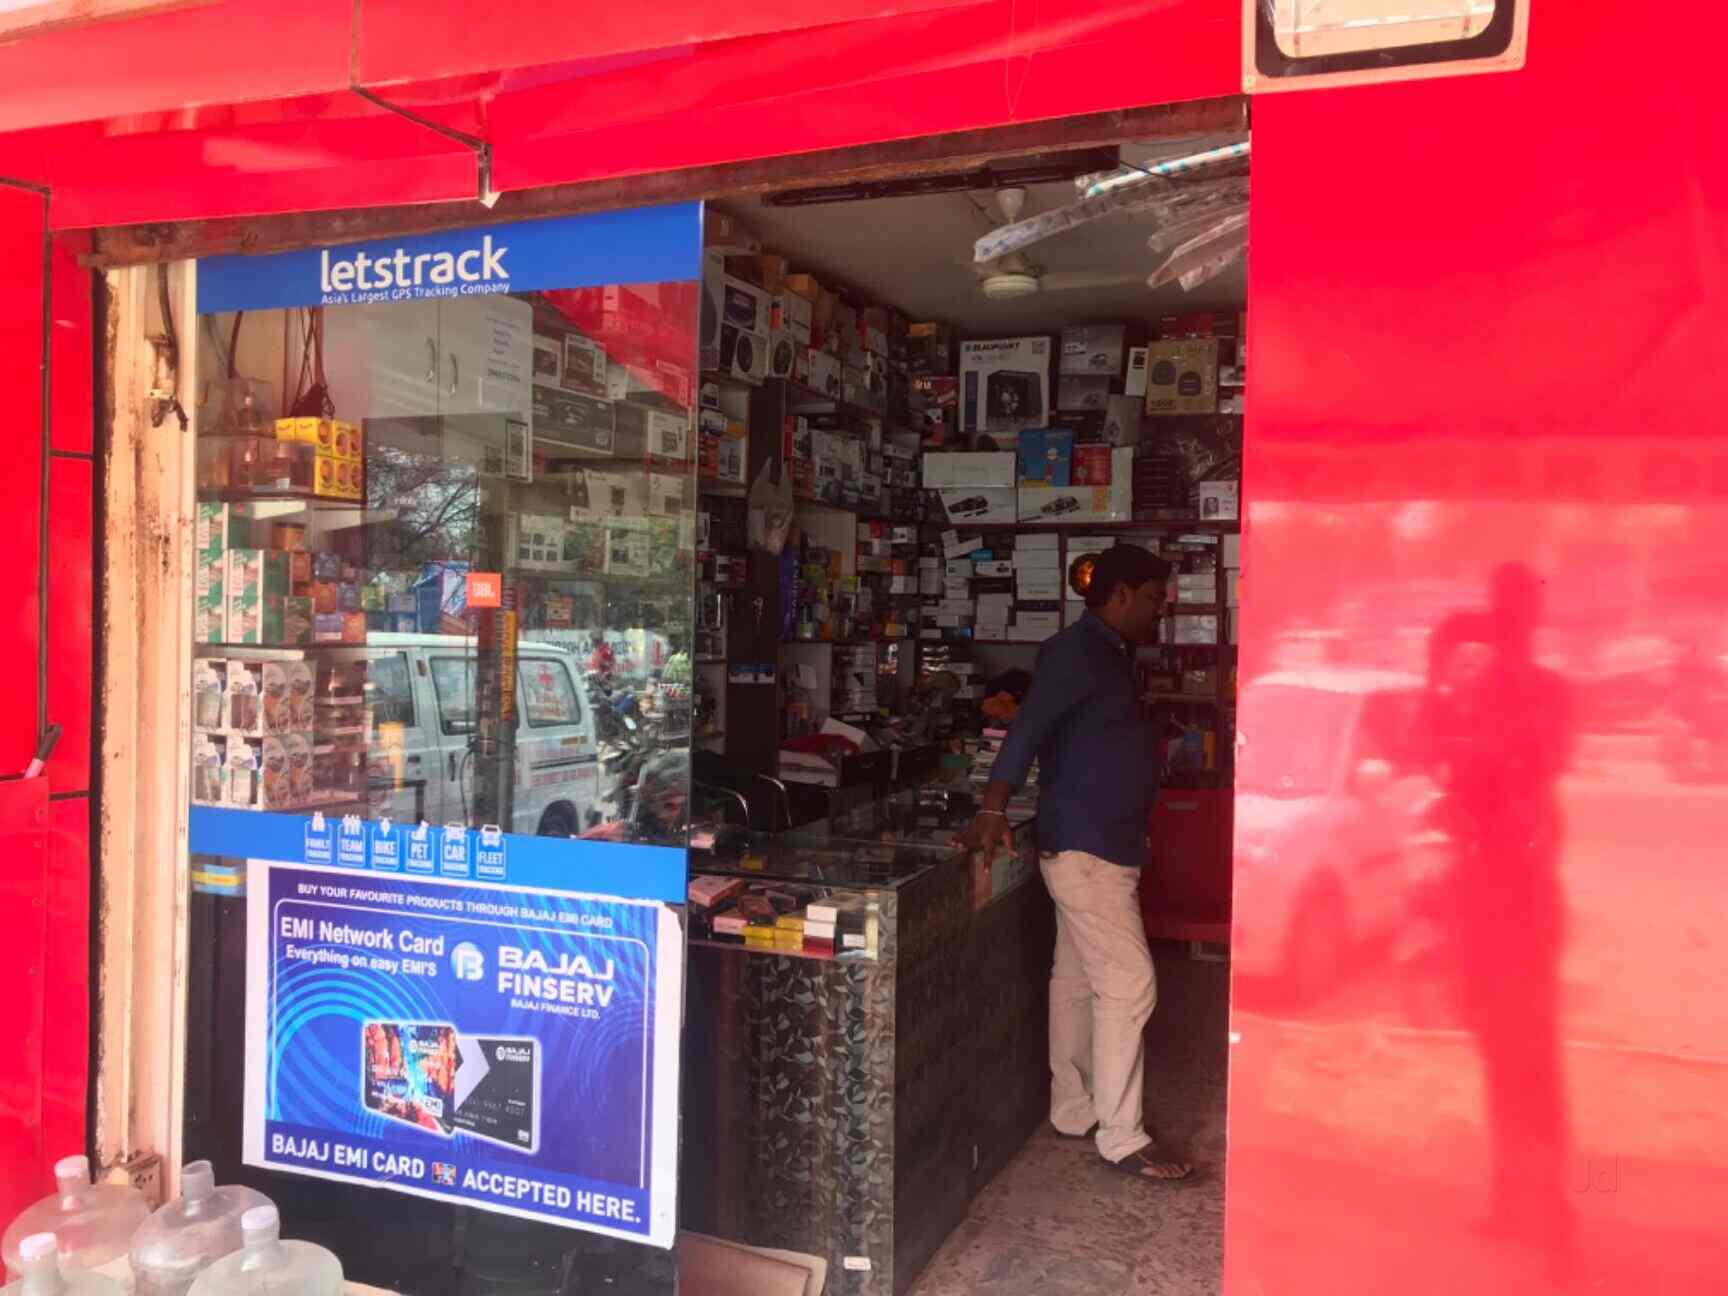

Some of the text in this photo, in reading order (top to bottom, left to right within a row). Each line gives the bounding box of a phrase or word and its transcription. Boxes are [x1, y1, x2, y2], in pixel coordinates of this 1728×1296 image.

[321, 235, 510, 293] letstrack
[321, 282, 511, 305] Asia's Largest GPS Tracking Company
[340, 840, 363, 852] TEAM
[374, 841, 397, 856] BIKE
[410, 843, 429, 859] PET
[445, 845, 467, 861] CAR
[479, 851, 504, 864] FLEET
[297, 883, 318, 895] BUY
[320, 885, 348, 898] YOUR
[350, 889, 404, 905] FAVOURITE
[406, 894, 464, 912] PRODUCTS
[467, 901, 519, 917] THROUGH
[520, 907, 557, 922] BAJAJ
[581, 914, 613, 928] CARD
[280, 916, 445, 957] EMI Network Card
[285, 944, 438, 977] Everything on easy EMI'S
[497, 945, 615, 981] BAJAJ
[497, 971, 615, 1008] FINSERV
[510, 998, 601, 1020] BAJAJ FINANCE LTD.
[271, 1133, 642, 1224] BAJAJ EMI CARD ACCEPTED HERE.
